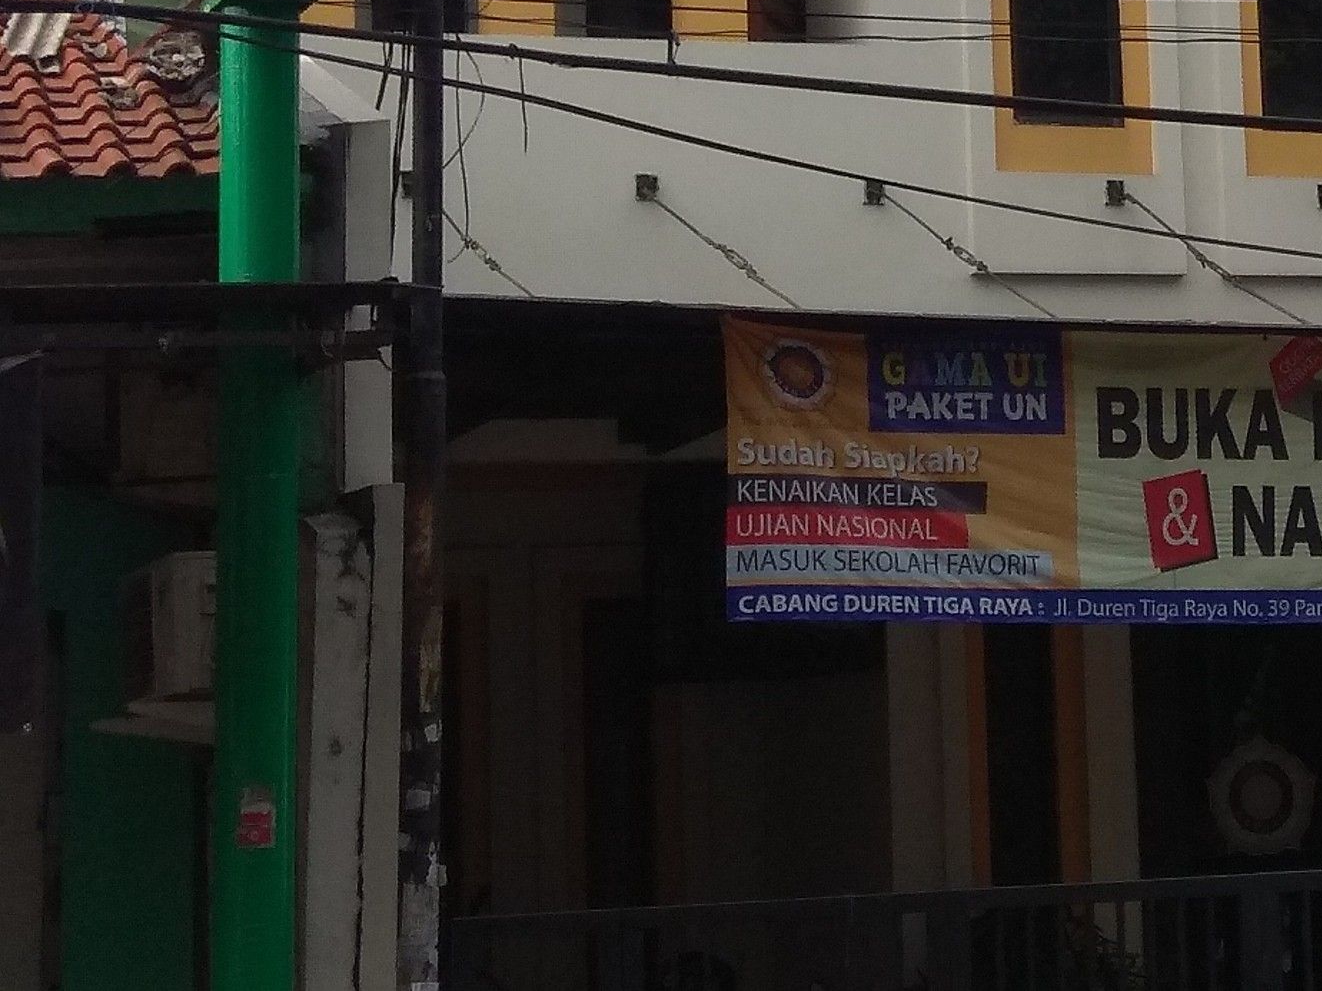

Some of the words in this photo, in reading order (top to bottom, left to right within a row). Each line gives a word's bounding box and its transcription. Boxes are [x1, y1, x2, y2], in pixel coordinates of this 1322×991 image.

[1003, 351, 1048, 388] UI
[884, 390, 994, 421] PAKET
[1002, 392, 1048, 422] UN
[1096, 385, 1290, 461] BUKA
[737, 437, 835, 469] Sudah
[843, 443, 981, 477] Siapkah?
[736, 479, 860, 506] KENAIKAN
[867, 484, 938, 508] KELAS
[736, 513, 810, 538] UJIAN
[816, 515, 939, 541] NASIONAL
[1161, 487, 1199, 547] &
[736, 549, 828, 573] MASUK
[833, 550, 940, 576] SEKOLAH
[946, 554, 1041, 577] FAVORIT
[738, 593, 837, 615] CABANG
[843, 594, 920, 614] DUREN
[923, 595, 974, 615] TIGA
[978, 596, 1034, 616] RAYA
[1053, 598, 1071, 617] Jl.
[1076, 598, 1136, 617] Duren
[1139, 598, 1180, 621] Tiga
[1183, 599, 1229, 621] Raya
[1233, 599, 1264, 617] No.
[1267, 599, 1291, 617] 39
